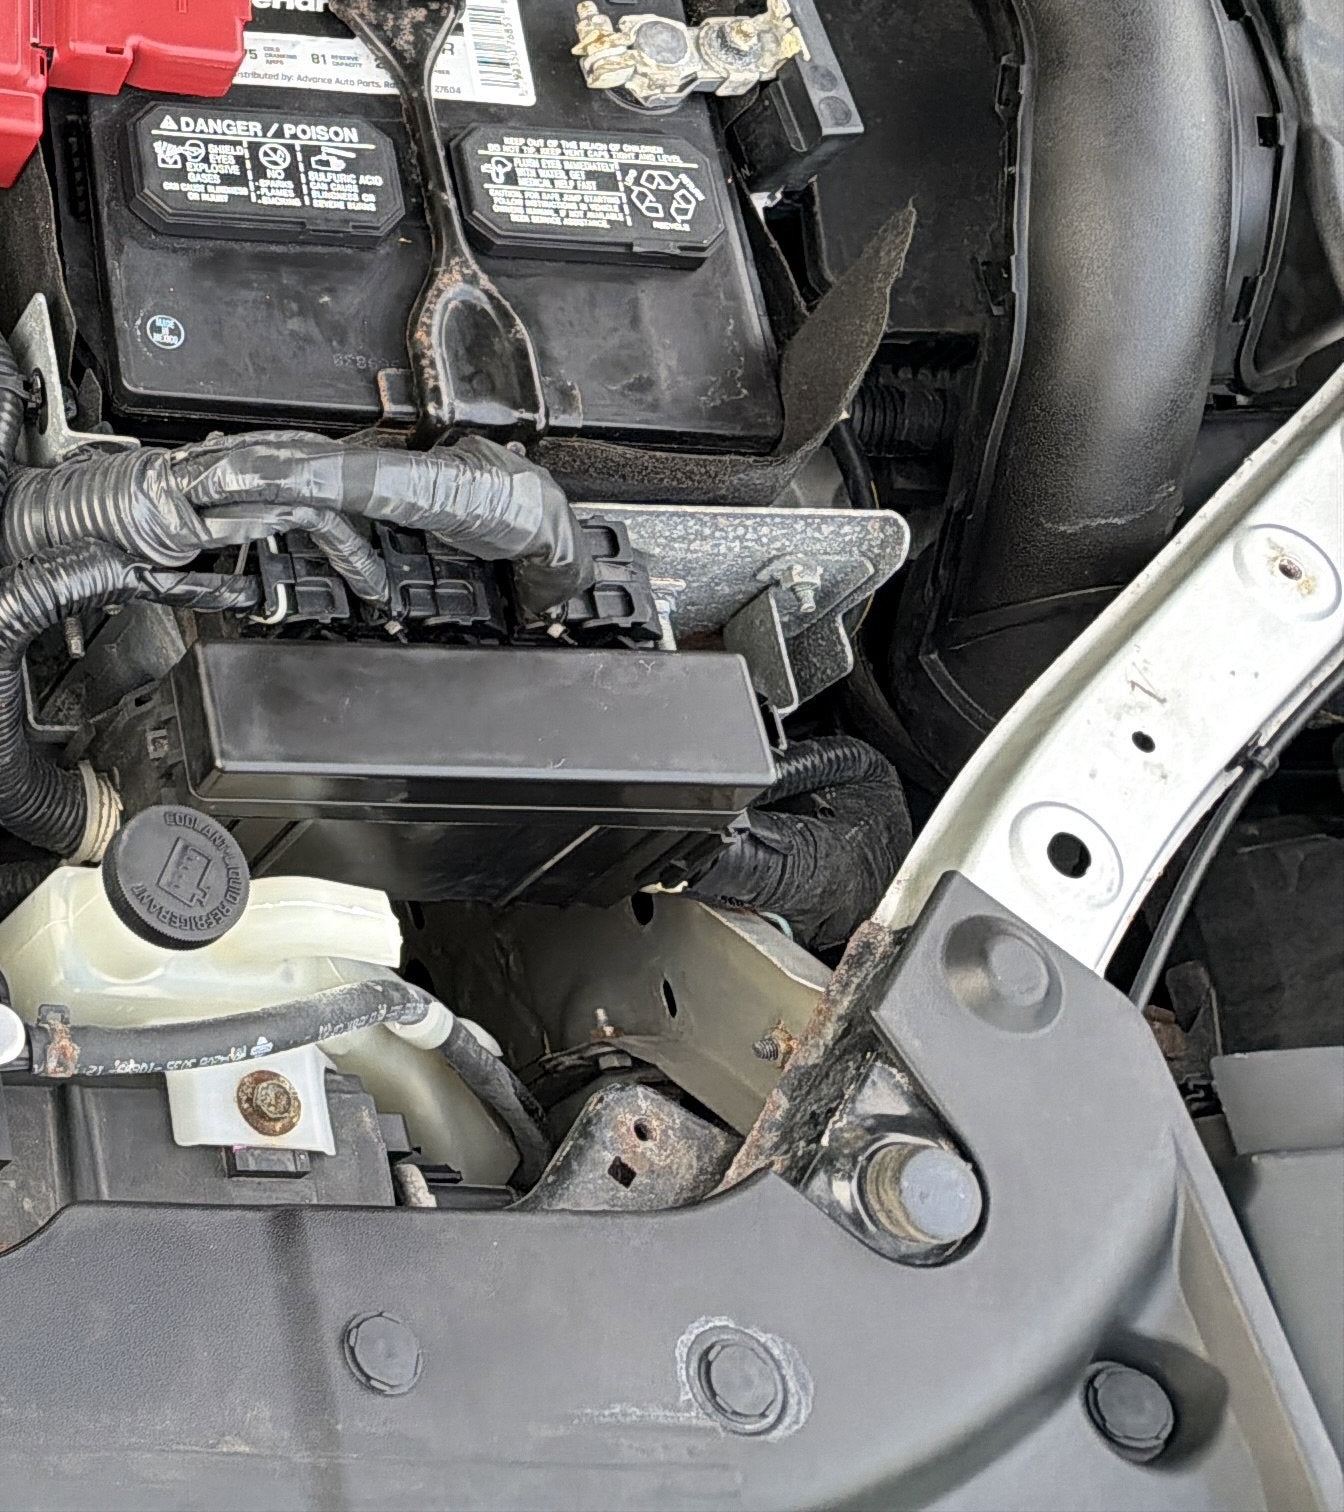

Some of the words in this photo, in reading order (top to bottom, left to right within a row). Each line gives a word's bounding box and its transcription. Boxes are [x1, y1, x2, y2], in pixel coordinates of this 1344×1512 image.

[311, 53, 327, 65] 81
[297, 74, 332, 85] Advance
[335, 78, 355, 87] Auto
[180, 116, 263, 137] DANGER
[267, 123, 280, 138] /
[283, 123, 359, 143] POISON
[526, 138, 544, 147] OUT
[207, 143, 244, 155] SHIELD
[209, 154, 236, 165] EYES
[186, 162, 241, 175] EXPLOSIVE
[266, 169, 285, 180] NO
[187, 172, 221, 184] GASES
[308, 171, 357, 185] SULFURIC
[359, 175, 383, 186] ACID
[309, 181, 328, 191] CAN
[330, 183, 359, 193] CAUSE
[130, 882, 233, 931] REFRIGERANT
